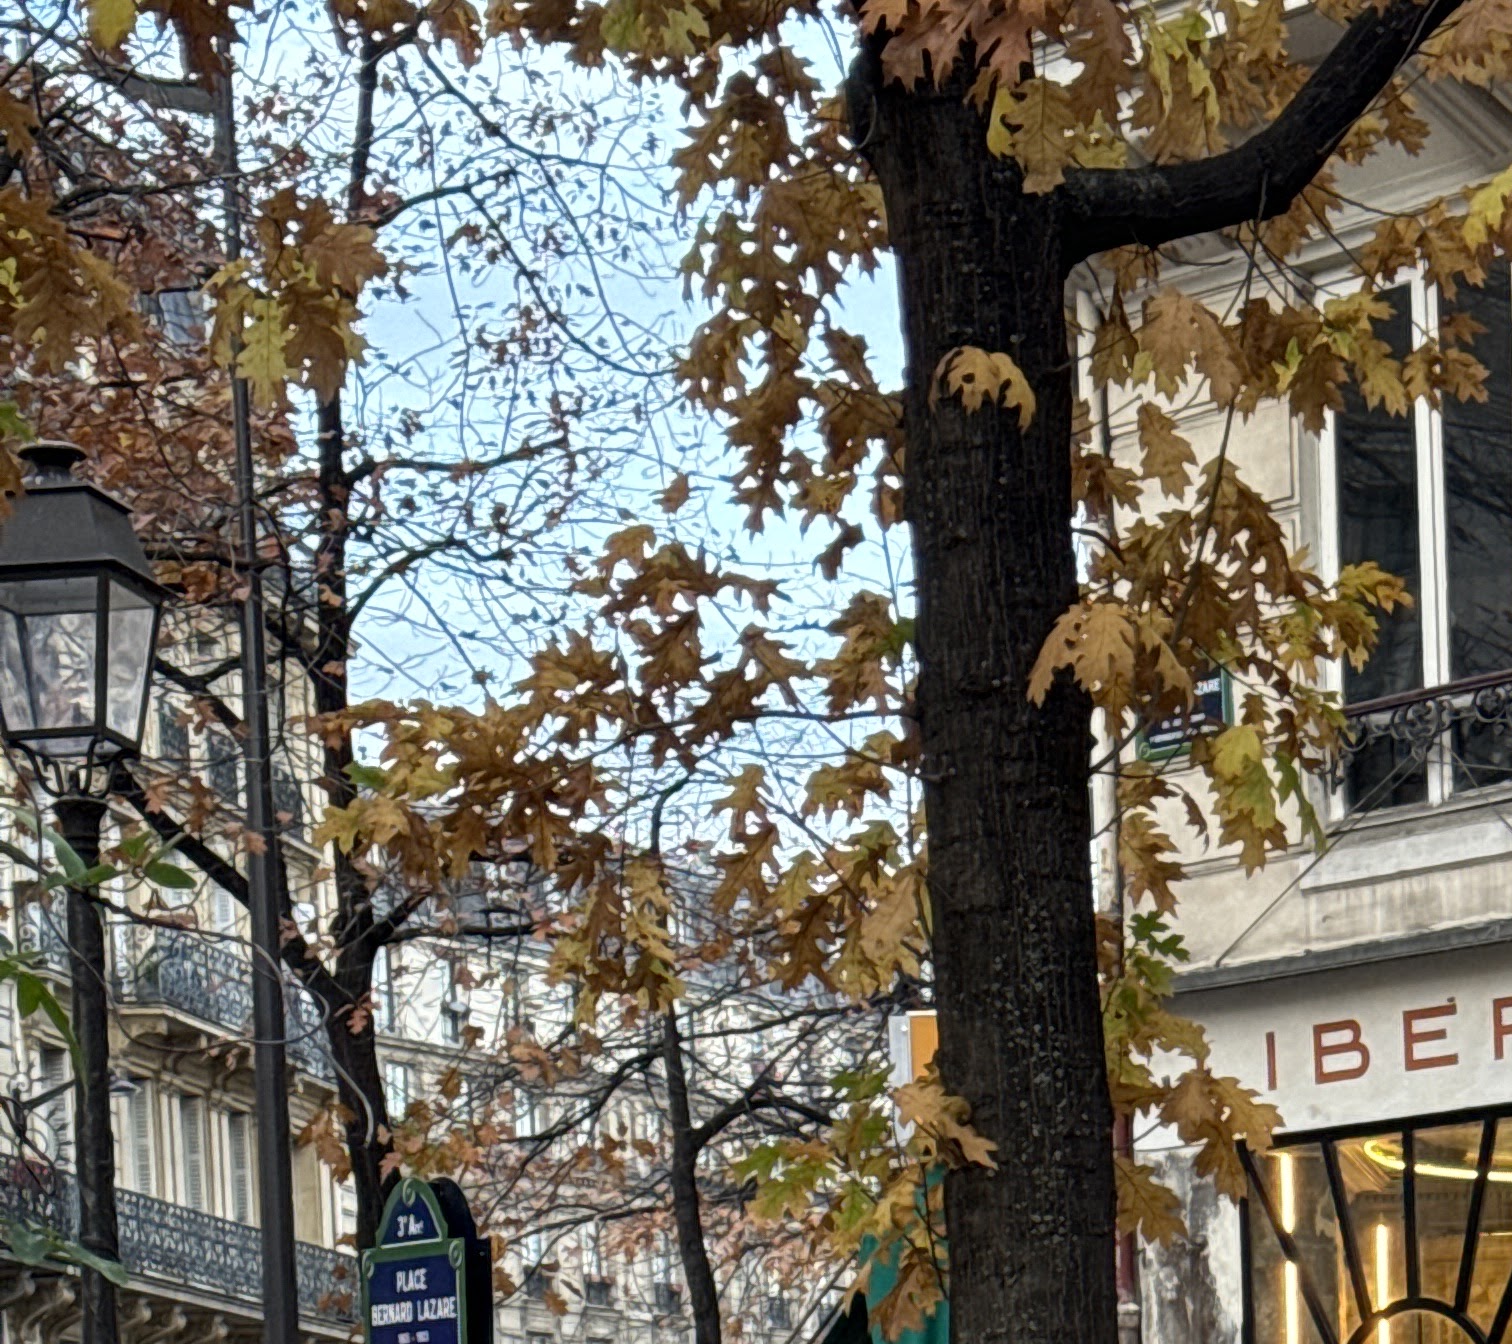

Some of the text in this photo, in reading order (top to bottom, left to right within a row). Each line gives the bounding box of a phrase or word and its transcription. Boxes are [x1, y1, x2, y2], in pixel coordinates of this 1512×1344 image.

[396, 1268, 428, 1293] PLACE
[371, 1296, 457, 1327] BERNARD LAZARE
